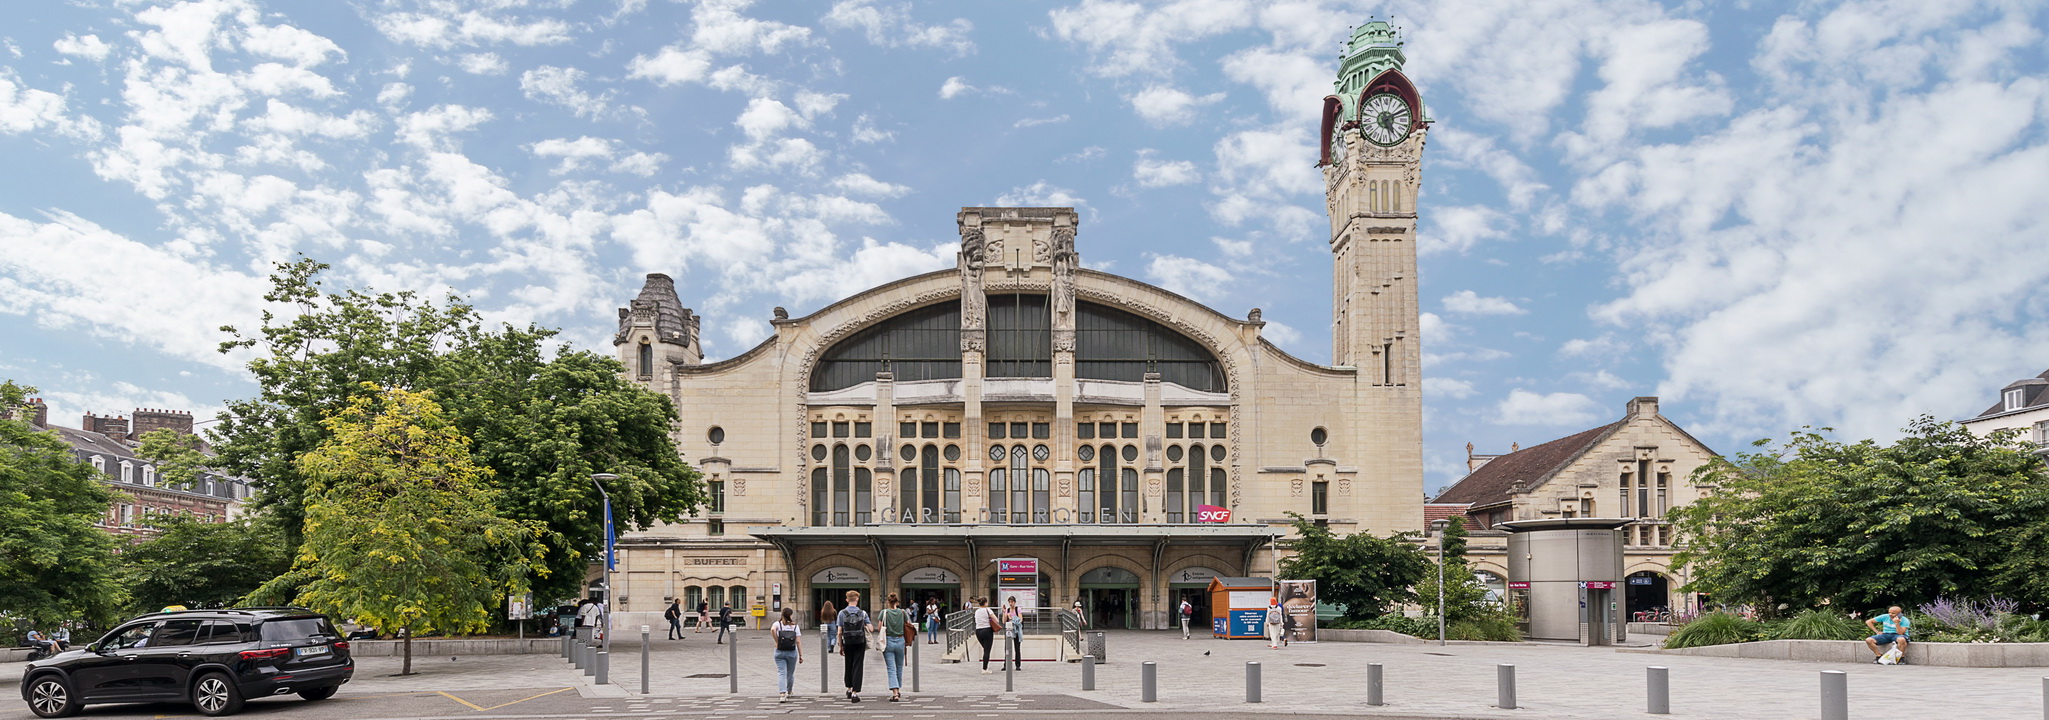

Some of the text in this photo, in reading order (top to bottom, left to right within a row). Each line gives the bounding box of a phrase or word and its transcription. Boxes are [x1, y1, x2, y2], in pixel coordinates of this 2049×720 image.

[881, 507, 1132, 524] GARE DE ROUEN
[1200, 510, 1230, 520] SNCF
